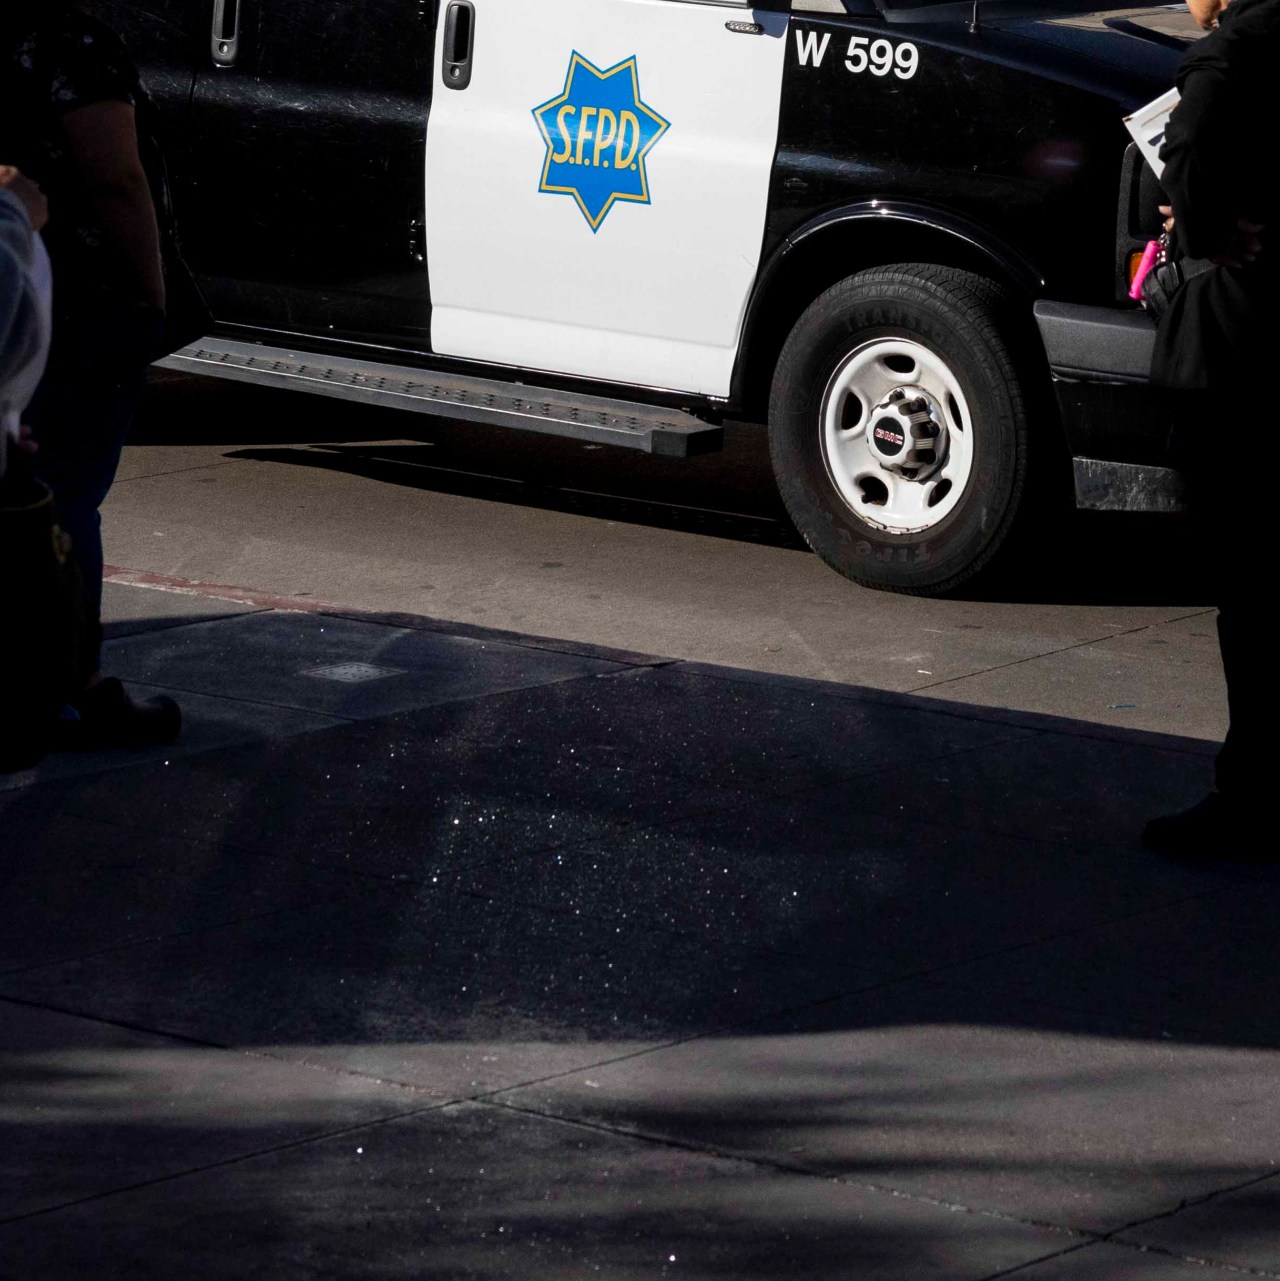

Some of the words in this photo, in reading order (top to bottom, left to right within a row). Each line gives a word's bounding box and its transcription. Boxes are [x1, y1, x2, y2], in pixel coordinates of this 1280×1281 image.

[795, 29, 830, 67] W
[844, 36, 919, 80] 599
[551, 104, 640, 172] S.F.P.D.
[874, 427, 904, 447] GMC
